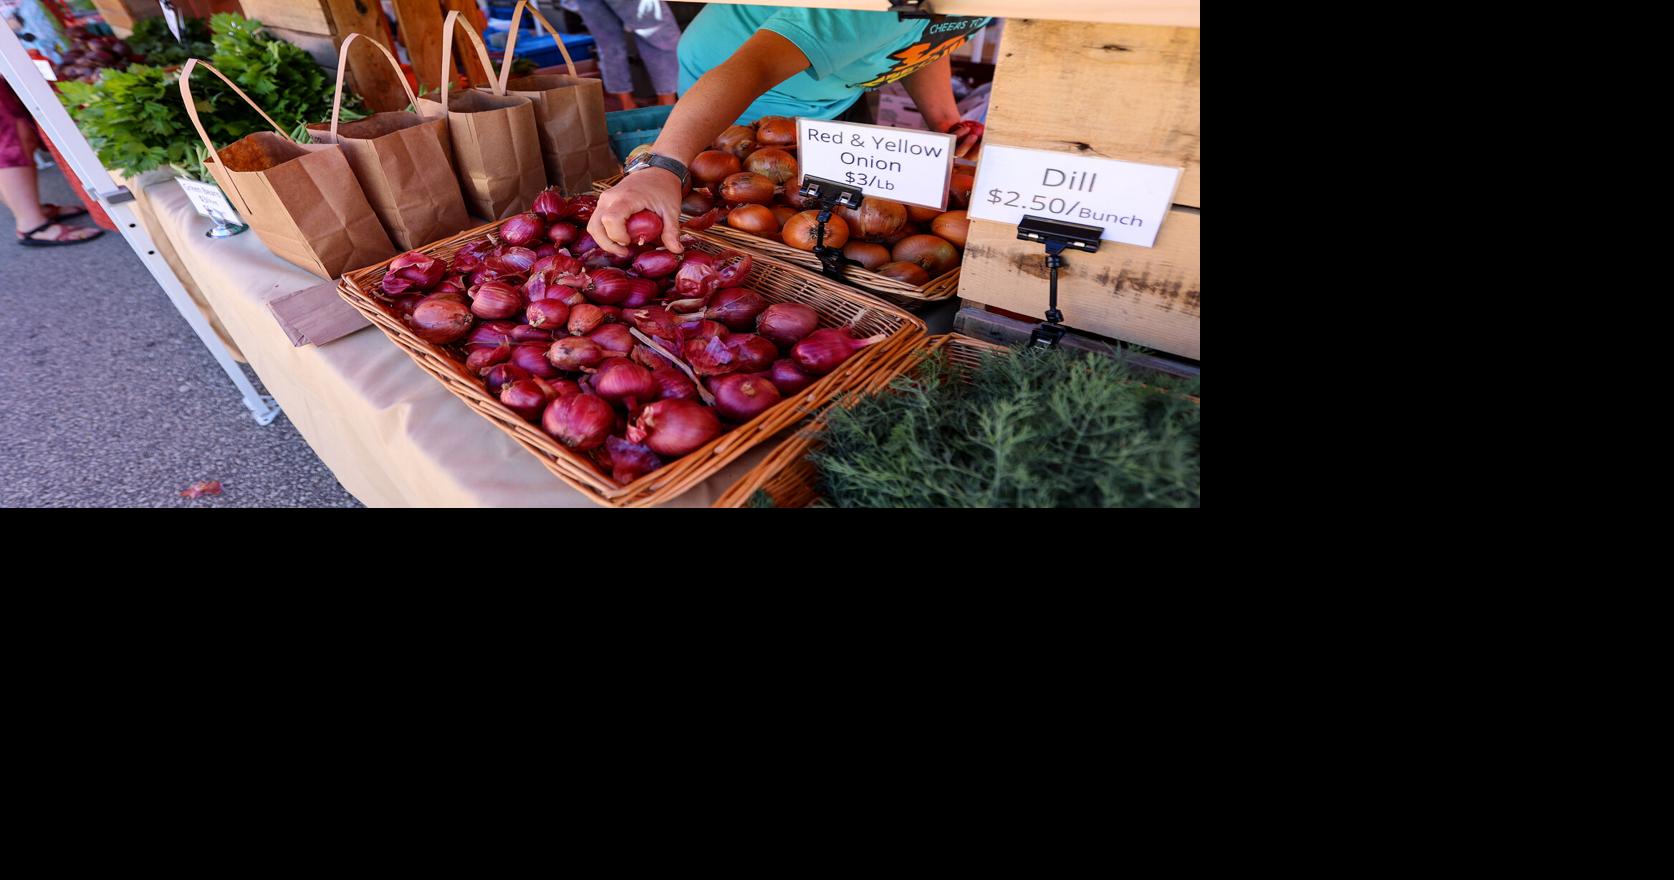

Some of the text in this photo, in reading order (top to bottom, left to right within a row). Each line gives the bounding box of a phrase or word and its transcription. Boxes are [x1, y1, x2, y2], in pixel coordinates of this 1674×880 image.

[930, 20, 968, 34] CHEERS
[808, 128, 942, 158] Red & Yellow
[840, 151, 901, 172] Onion
[845, 171, 895, 191] $3/Lb
[1042, 168, 1097, 193] Dill
[987, 188, 1143, 227] $2.50/Bunch
